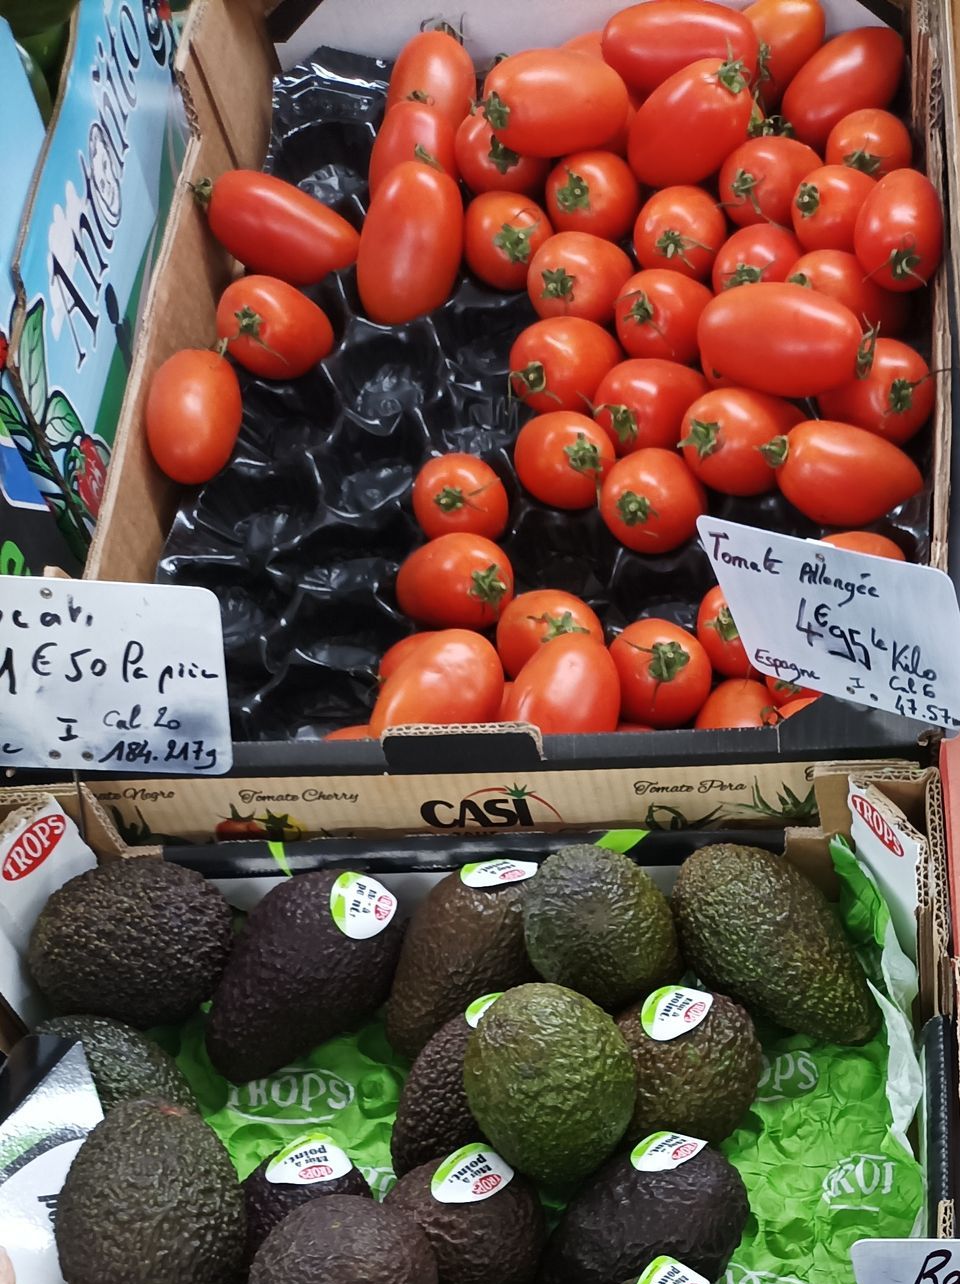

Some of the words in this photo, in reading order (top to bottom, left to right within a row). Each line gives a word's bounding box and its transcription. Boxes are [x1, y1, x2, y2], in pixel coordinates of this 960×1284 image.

[754, 648, 820, 684] Espagne
[418, 797, 536, 829] CASI
[853, 796, 903, 856] TROPS
[4, 815, 66, 880] TROPS
